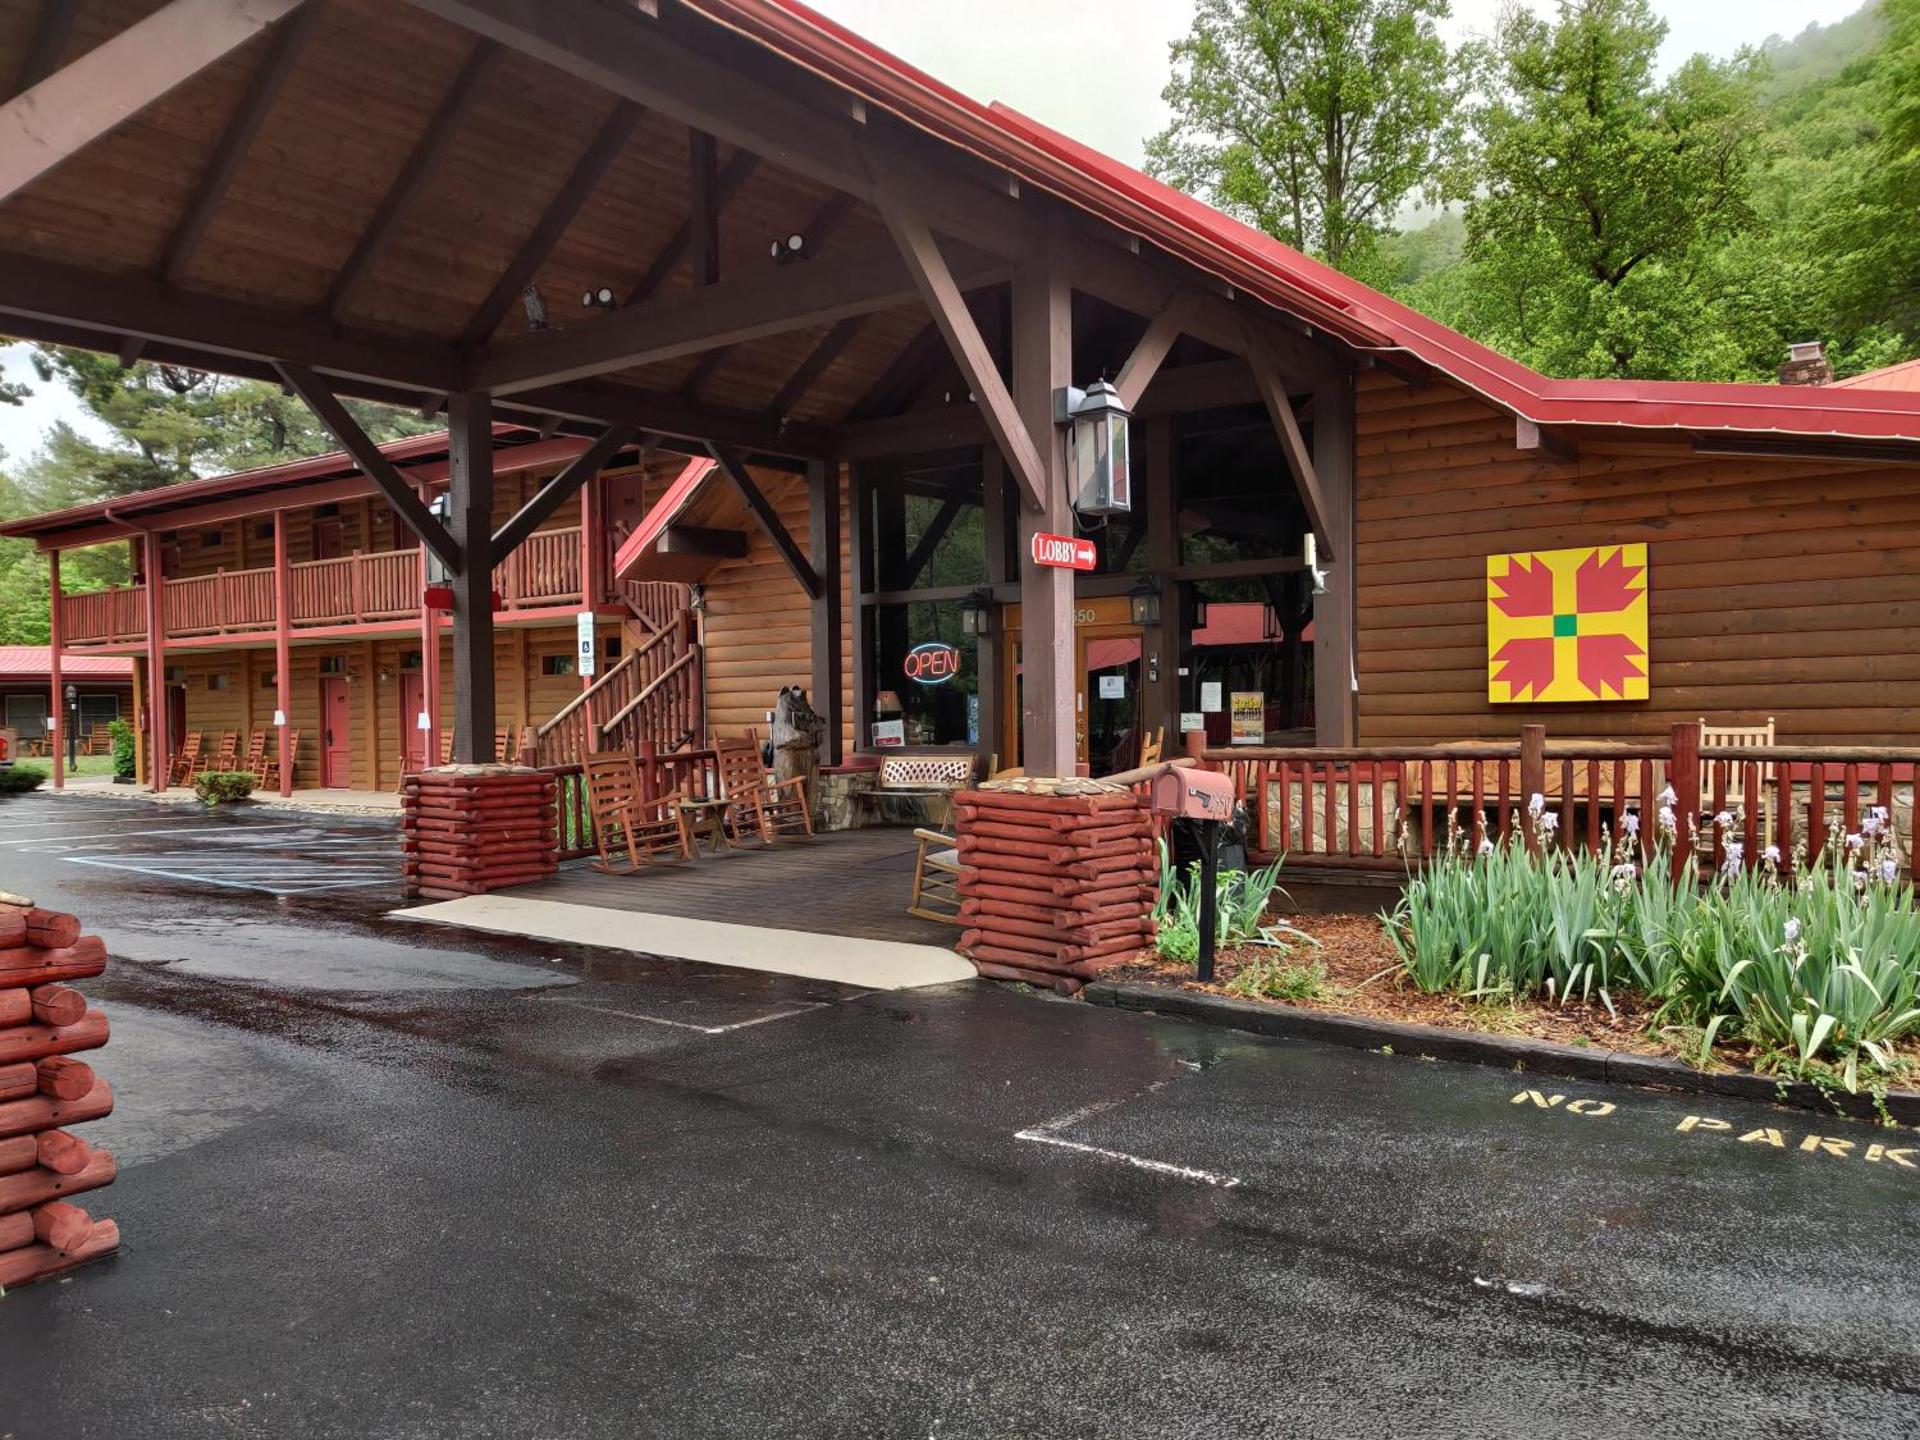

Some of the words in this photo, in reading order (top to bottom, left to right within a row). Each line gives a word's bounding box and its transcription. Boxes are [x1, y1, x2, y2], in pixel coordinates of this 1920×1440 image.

[1038, 538, 1077, 564] LOBBY
[904, 649, 959, 677] OPEN
[1510, 1089, 1616, 1116] NO
